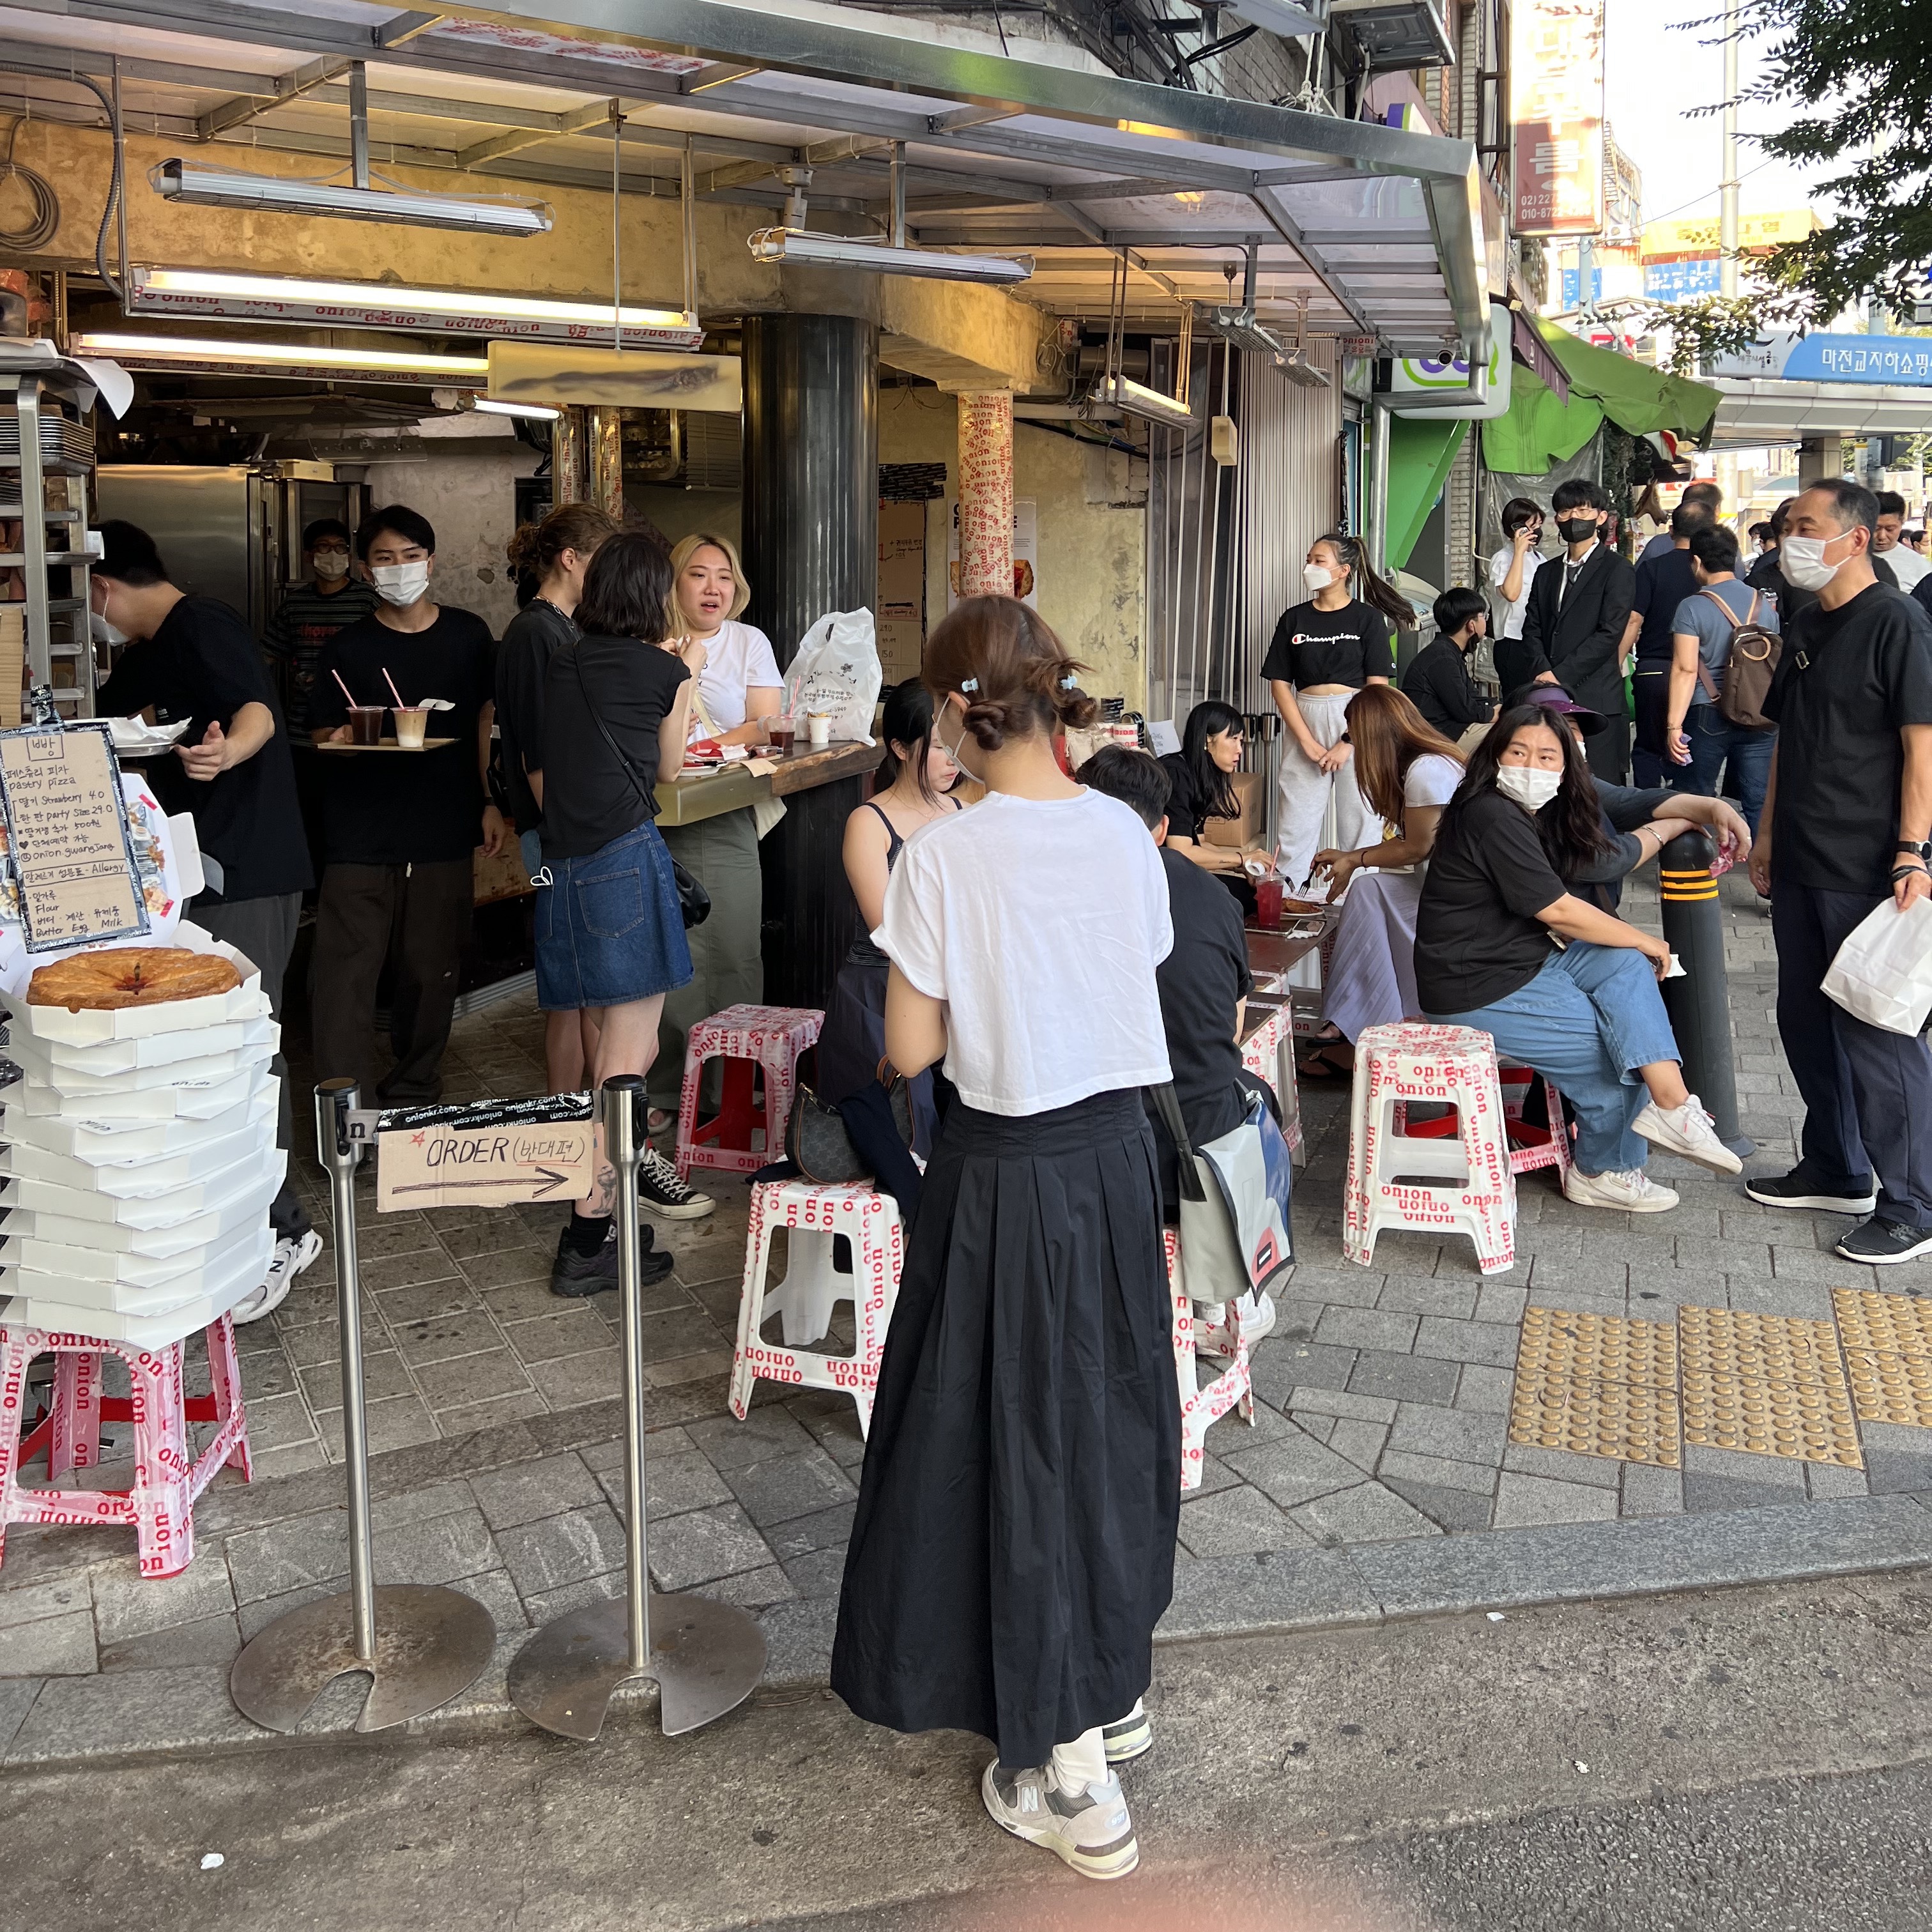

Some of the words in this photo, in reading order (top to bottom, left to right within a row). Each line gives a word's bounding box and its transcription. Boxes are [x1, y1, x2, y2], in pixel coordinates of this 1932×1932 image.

[1822, 348, 1932, 377] 마전교지하쇼핑
[1292, 632, 1361, 645] Champion
[48, 765, 70, 776] 피자
[9, 780, 42, 792] pastry
[49, 777, 77, 790] pizza
[42, 793, 82, 806] Strawberry
[89, 790, 105, 800] 4.0
[47, 809, 70, 822] party
[92, 805, 113, 814] 29.0
[92, 863, 125, 874] Allergy
[35, 904, 60, 916] Flour
[36, 926, 65, 938] Butter
[72, 923, 90, 934] Egg
[102, 917, 123, 929] Milk
[37, 915, 55, 925] 버터
[694, 1031, 718, 1058] onio
[1396, 1084, 1446, 1096] onion
[505, 1096, 556, 1112] onionkr.com
[405, 1106, 458, 1123] onionkr.com
[427, 1137, 509, 1167] ORDER
[683, 1148, 714, 1163] nion
[1484, 1142, 1502, 1193] onion
[1381, 1186, 1432, 1201] onion
[1399, 1199, 1450, 1213] onion
[859, 1203, 870, 1265] onion
[887, 1222, 901, 1284] onion
[871, 1248, 883, 1309] onion
[746, 1347, 794, 1367] onion
[76, 1353, 91, 1410] onion
[751, 1366, 802, 1383] onion
[56, 1392, 64, 1452] onion
[1022, 1786, 1039, 1813] N
[1110, 1811, 1127, 1827] 991
